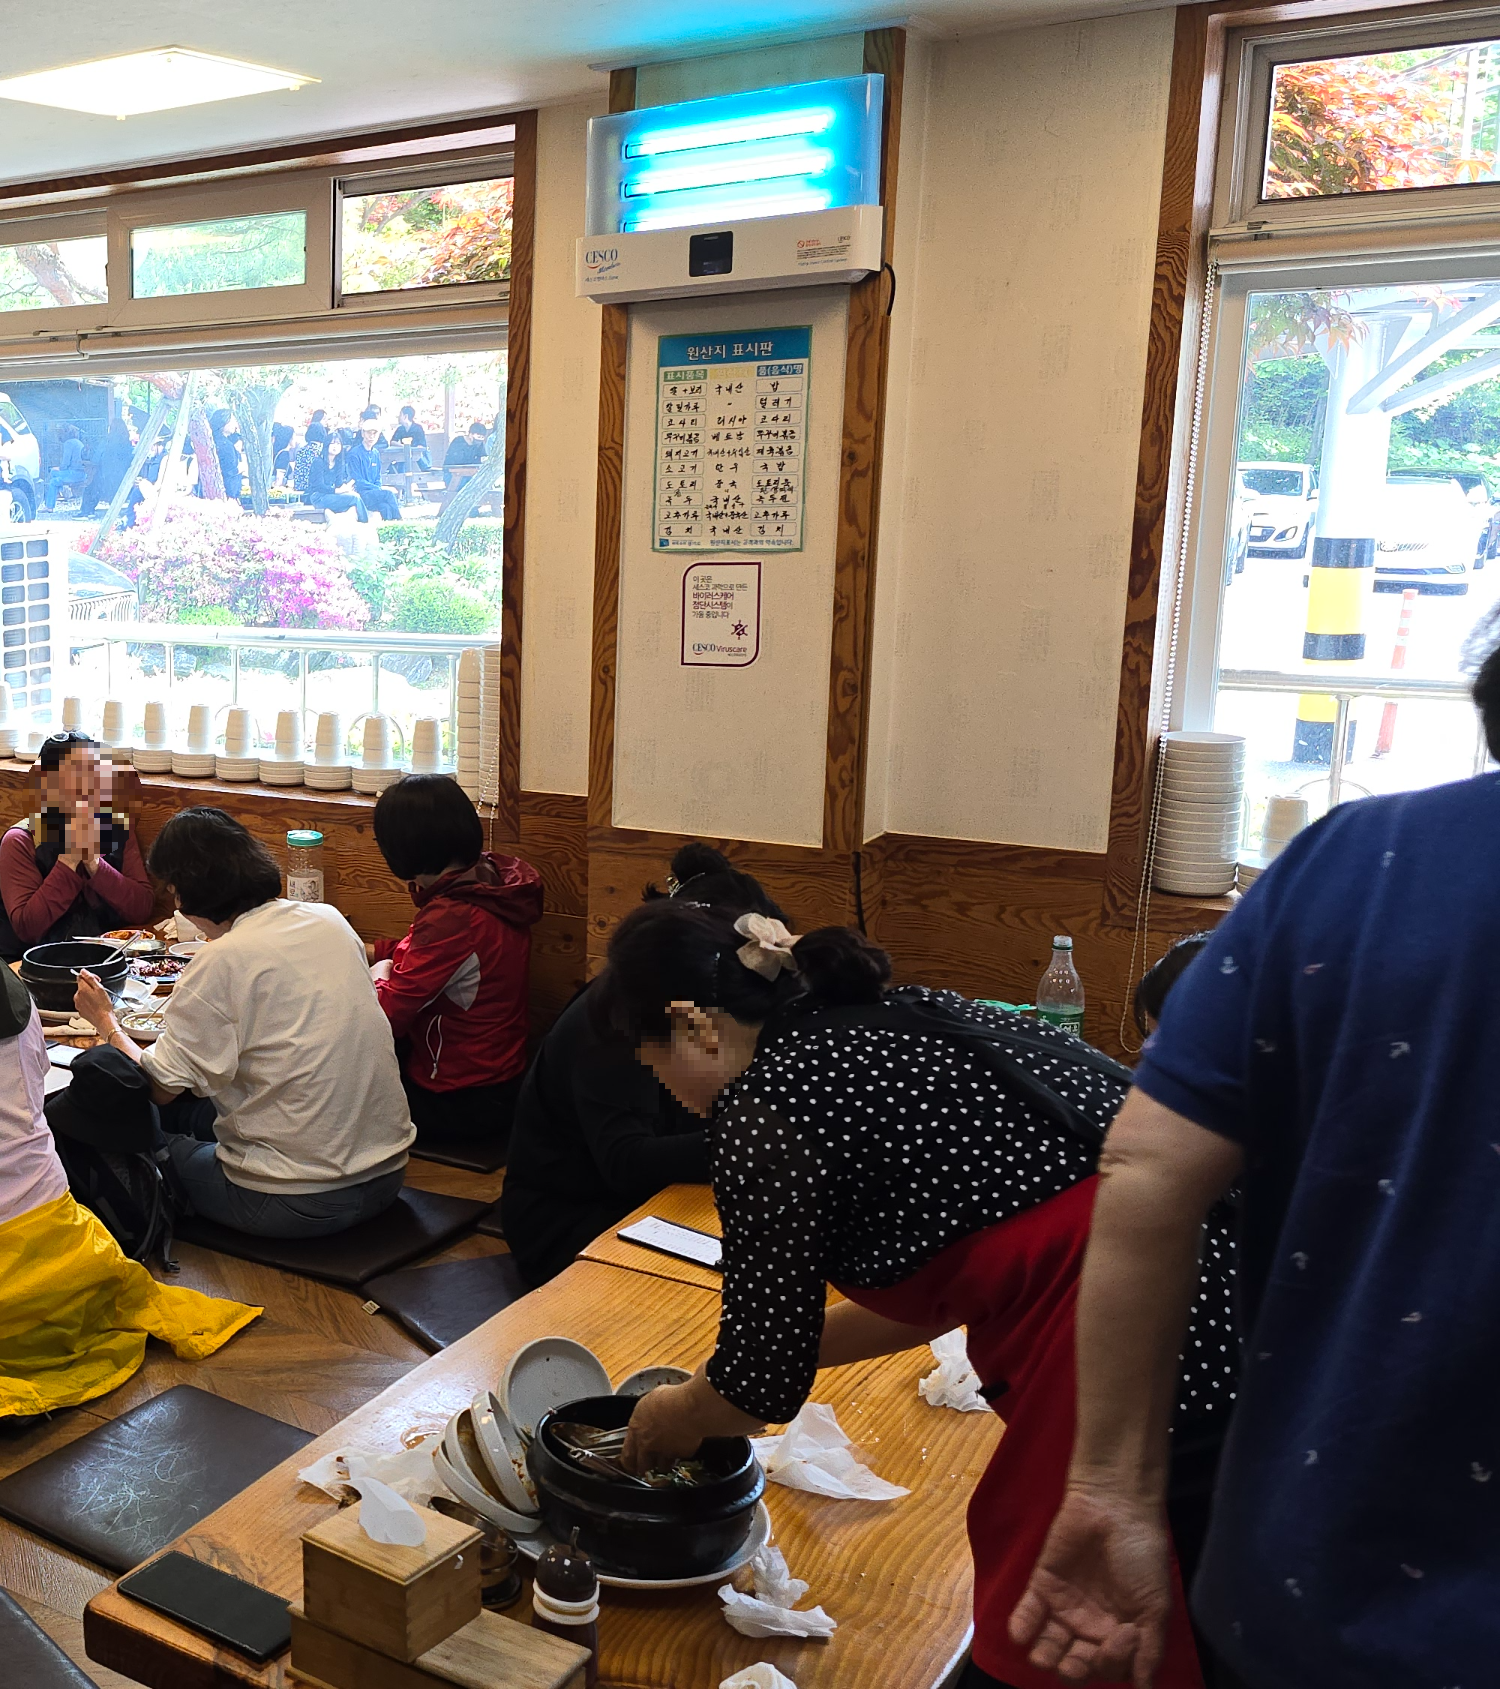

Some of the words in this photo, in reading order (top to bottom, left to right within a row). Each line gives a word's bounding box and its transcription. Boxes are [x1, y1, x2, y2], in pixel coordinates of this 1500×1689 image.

[585, 249, 618, 263] CESCO
[687, 344, 727, 361] 원산지
[731, 341, 773, 357] 표시판
[667, 369, 705, 380] 표시품목
[759, 364, 803, 376] 품(음식)명
[715, 382, 744, 395] 국내산
[769, 380, 780, 393] 밥
[717, 415, 748, 427] 러시아
[711, 431, 745, 442] 베트남
[665, 448, 699, 461] 돼지고기
[756, 445, 794, 457] 제육볶음
[665, 463, 698, 474] 소고기
[715, 462, 739, 473] 한우
[760, 460, 786, 472] 국밥
[665, 480, 698, 490] 도토리
[715, 479, 738, 489] 중국
[710, 494, 742, 505] 국내산
[664, 510, 700, 521] 고추가루
[753, 509, 790, 521] 고추가루
[664, 526, 693, 536] 김치
[709, 525, 743, 537] 국내산
[757, 524, 784, 537] 김치
[711, 583, 735, 591] 과학으로
[692, 592, 734, 600] 바이러스케어
[692, 601, 733, 610] 첨단시스템이
[692, 611, 704, 619] 가동
[705, 610, 730, 619] 중입니다
[692, 643, 716, 652] CESCO
[717, 645, 748, 653] Viruscare
